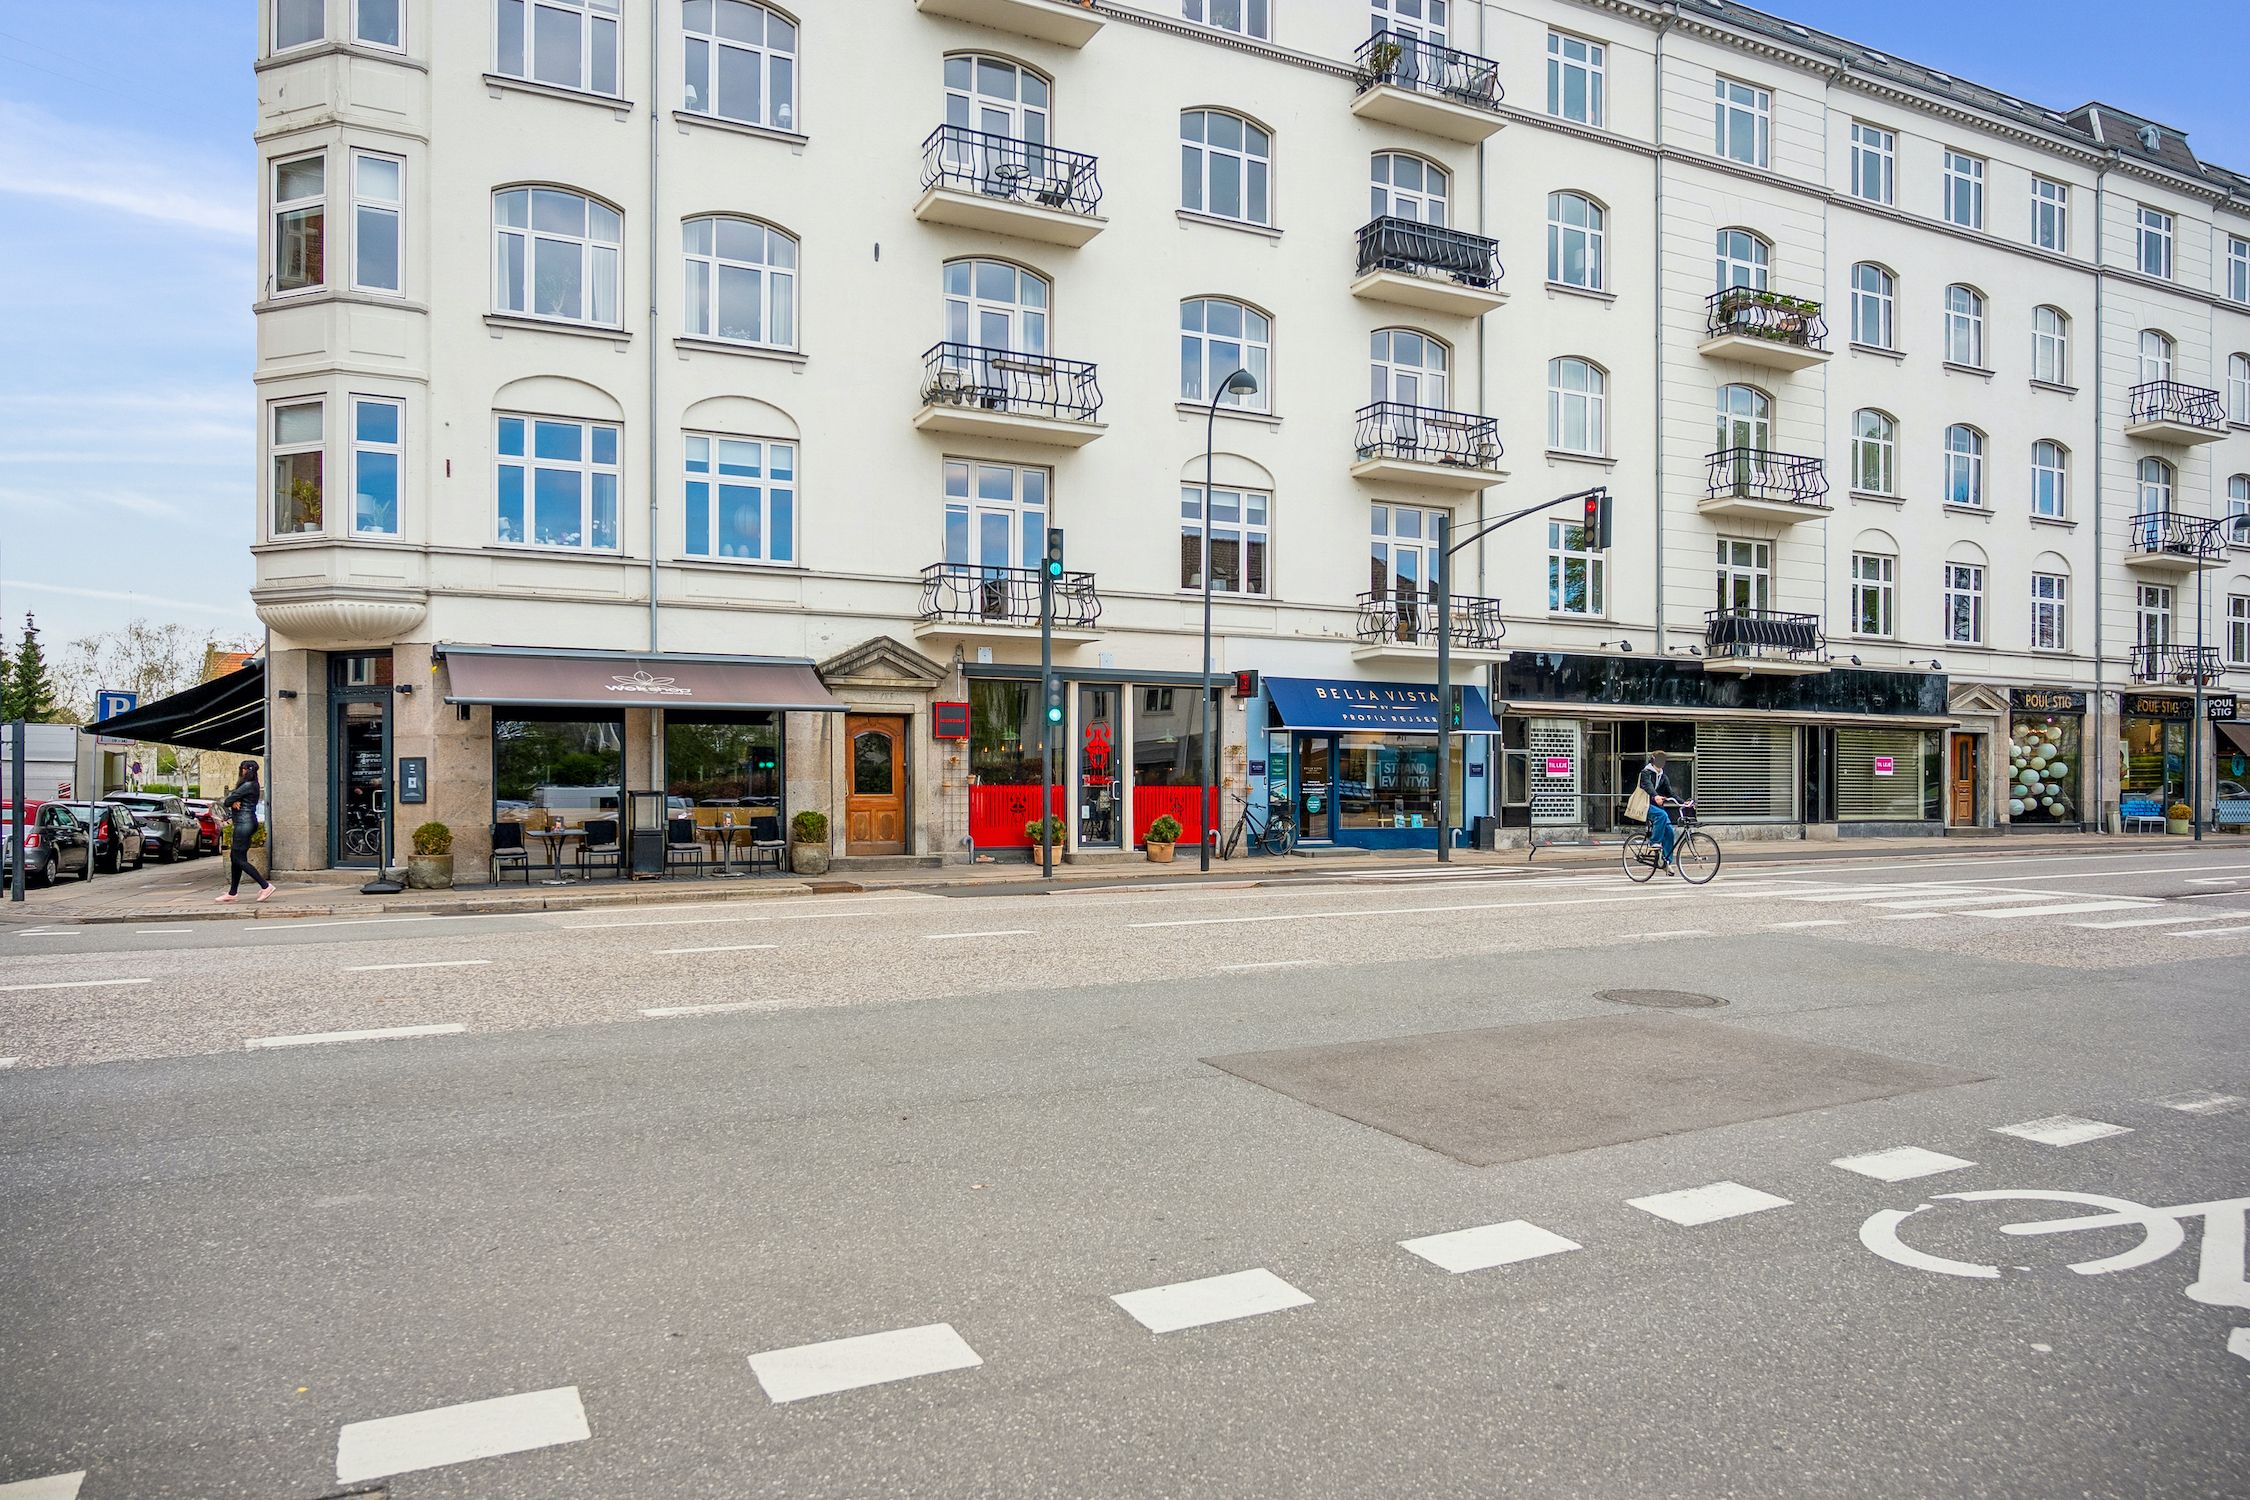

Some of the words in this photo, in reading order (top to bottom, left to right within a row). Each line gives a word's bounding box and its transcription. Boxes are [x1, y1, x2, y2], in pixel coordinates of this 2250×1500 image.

[1315, 687, 1379, 701] BELLA
[1385, 690, 1439, 703] VISTA
[2025, 694, 2049, 708] POUL
[2052, 695, 2072, 709] STIG
[106, 697, 130, 720] P
[2137, 700, 2158, 713] POUL
[2161, 700, 2179, 714] STIG
[2208, 699, 2234, 708] POUL
[1342, 713, 1386, 722] PROFIL
[1391, 715, 1438, 723] REJSER
[2210, 708, 2232, 717] STIG
